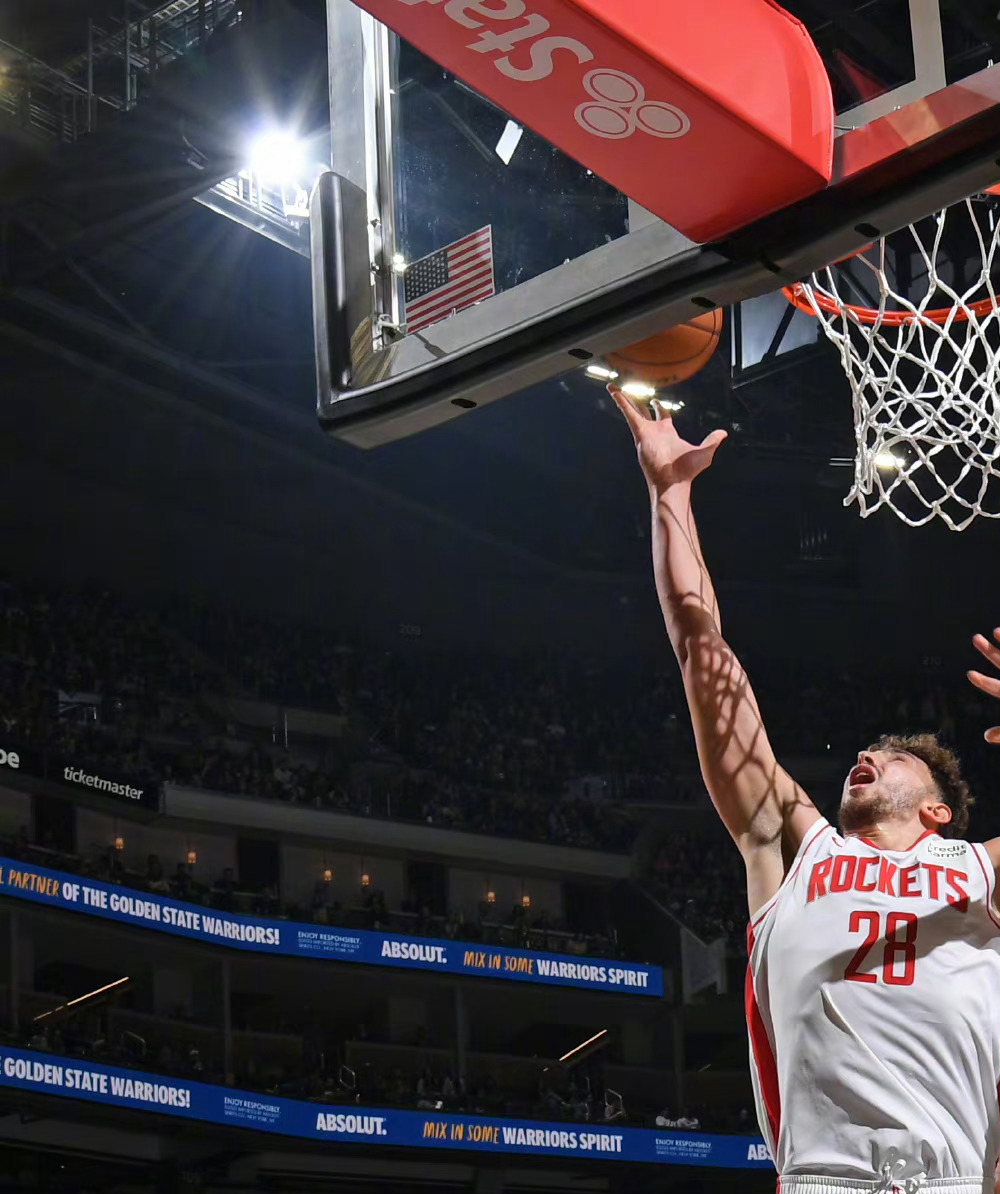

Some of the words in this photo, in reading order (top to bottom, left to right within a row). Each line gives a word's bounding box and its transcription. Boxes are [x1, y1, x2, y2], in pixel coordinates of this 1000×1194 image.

[398, 0, 594, 82] Sta
[63, 766, 144, 800] ticketmaster
[806, 854, 970, 914] ROCKETS
[8, 869, 60, 897] PARTNER
[62, 882, 80, 902] OF
[82, 886, 108, 910] THE
[109, 893, 161, 922] GOLDEN
[162, 907, 201, 931] STATE
[201, 915, 280, 946] WARRIORS!
[381, 940, 448, 964] ABSOLUT.
[463, 951, 486, 969] MIX
[488, 954, 502, 970] IN
[504, 956, 534, 975] SOME
[536, 959, 608, 983] WARRIORS
[608, 968, 649, 988] SPIRIT
[844, 910, 918, 986] 28
[4, 1057, 63, 1087] GOLDEN
[65, 1068, 108, 1094] STATE
[110, 1076, 191, 1109] WARRIORS!
[316, 1112, 388, 1136] ABSOLUT.
[423, 1121, 447, 1139] MIX
[450, 1124, 464, 1140] IN
[467, 1125, 500, 1145] SOME
[501, 1127, 578, 1150] WARRIORS
[579, 1133, 623, 1153] SPIRIT
